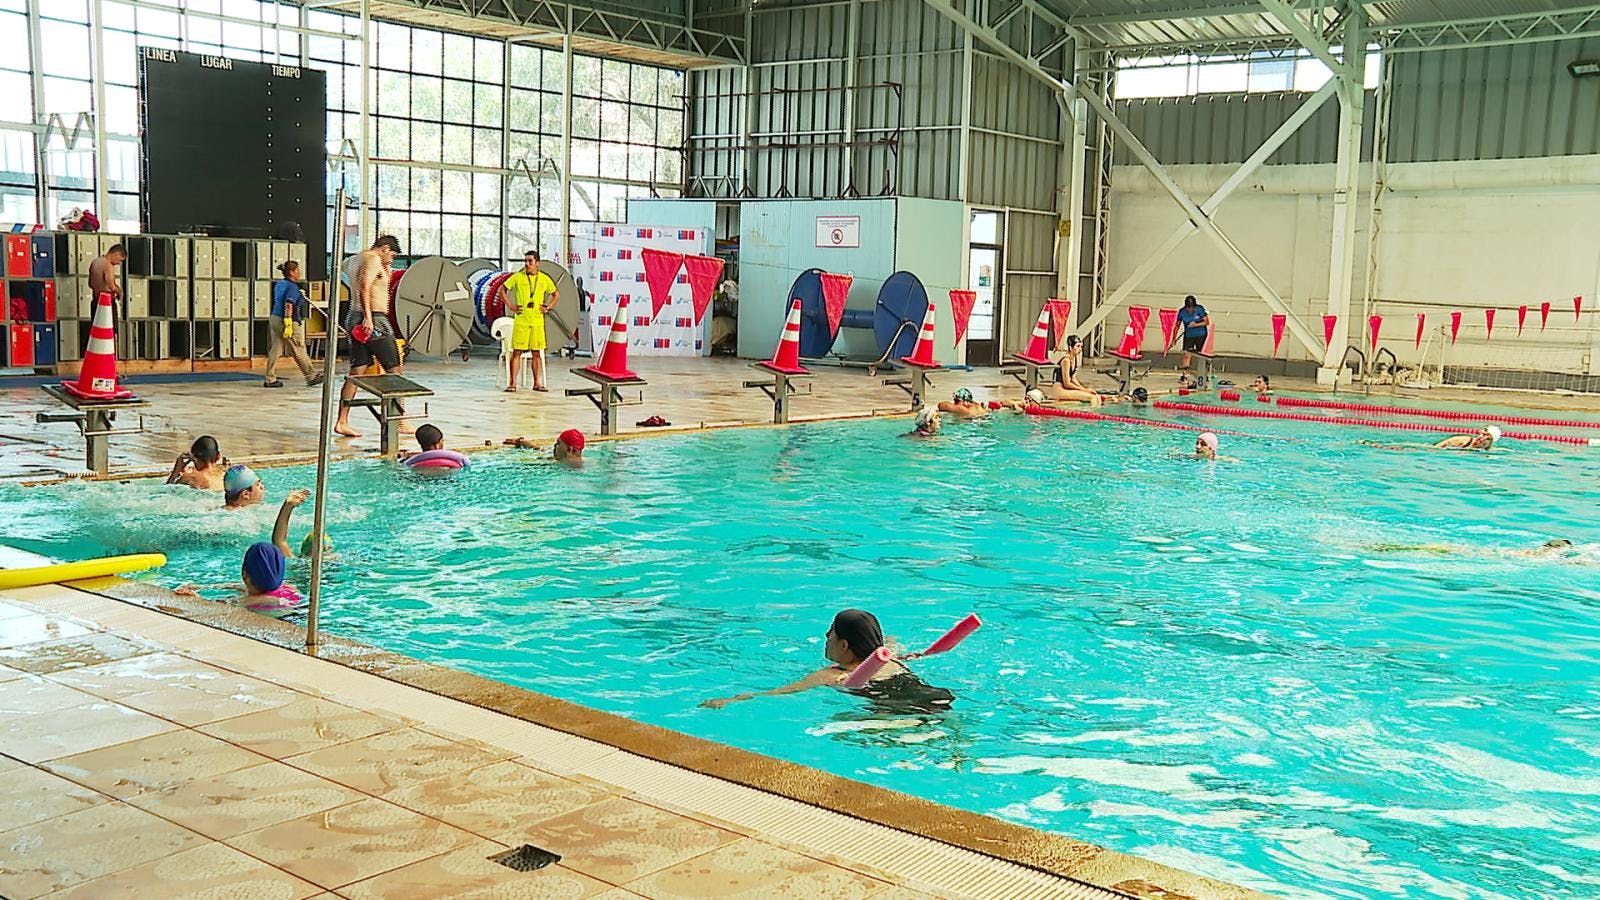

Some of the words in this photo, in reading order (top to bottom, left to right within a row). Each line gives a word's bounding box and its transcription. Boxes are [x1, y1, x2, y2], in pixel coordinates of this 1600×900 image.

[146, 48, 177, 63] LINEA
[201, 56, 233, 71] LUGAR
[272, 65, 301, 79] TIEMPO
[1119, 380, 1127, 392] 7
[912, 392, 920, 406] 5
